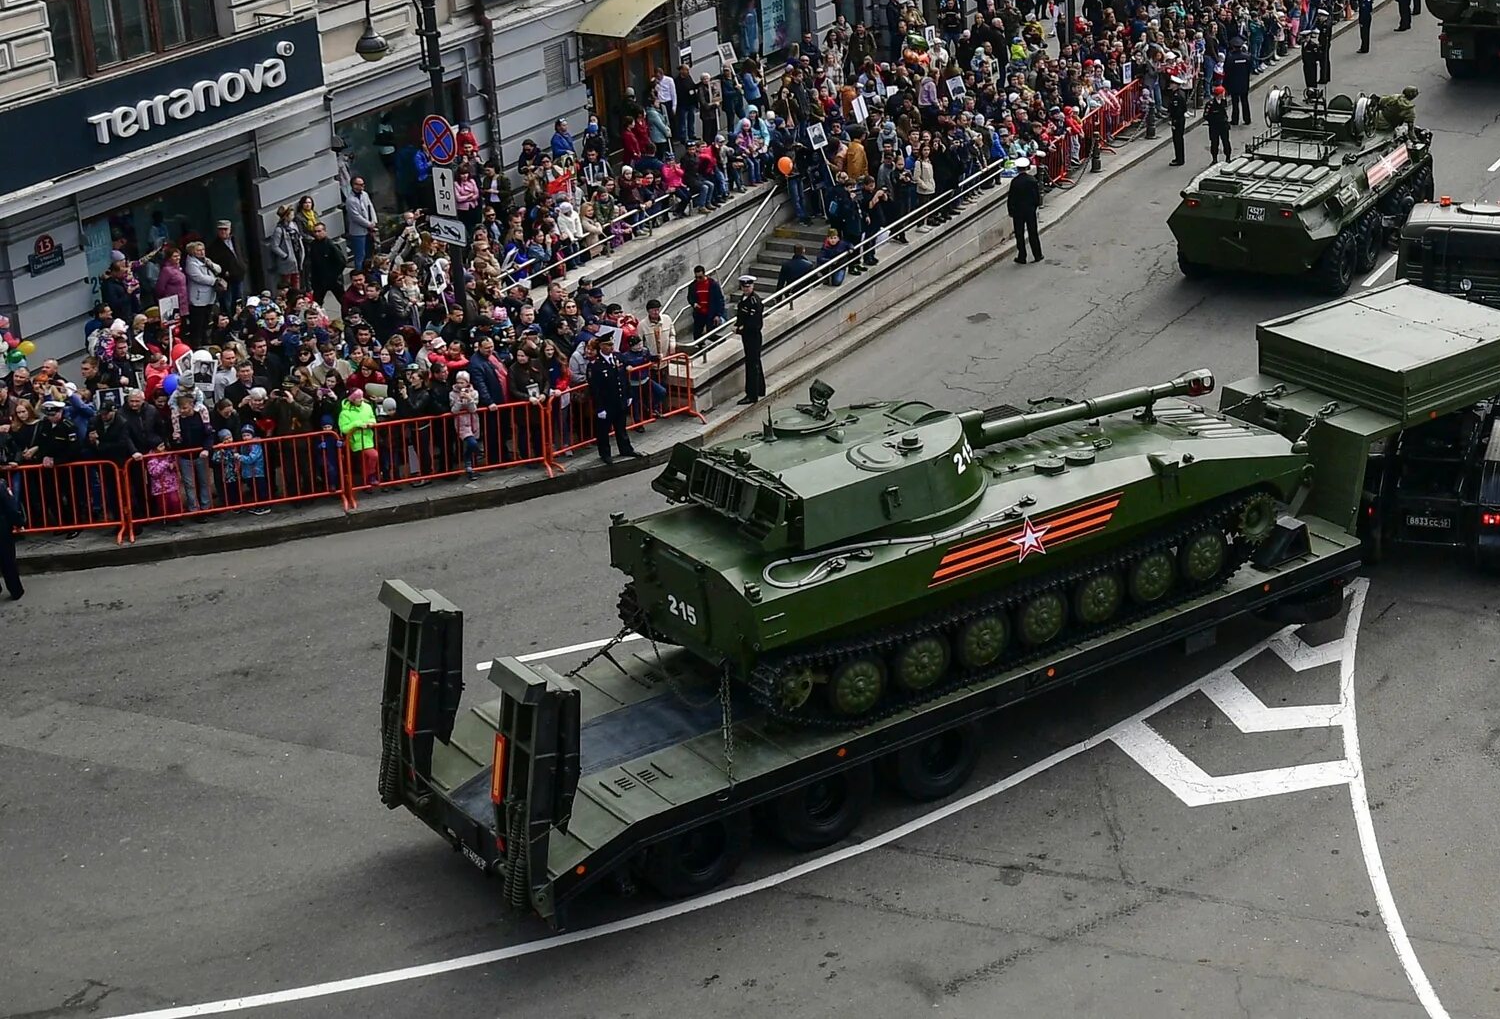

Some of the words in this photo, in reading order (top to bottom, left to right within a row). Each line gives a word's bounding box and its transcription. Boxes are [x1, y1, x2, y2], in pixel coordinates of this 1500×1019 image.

[439, 189, 451, 201] 50
[38, 238, 52, 253] 13
[667, 594, 697, 626] 215
